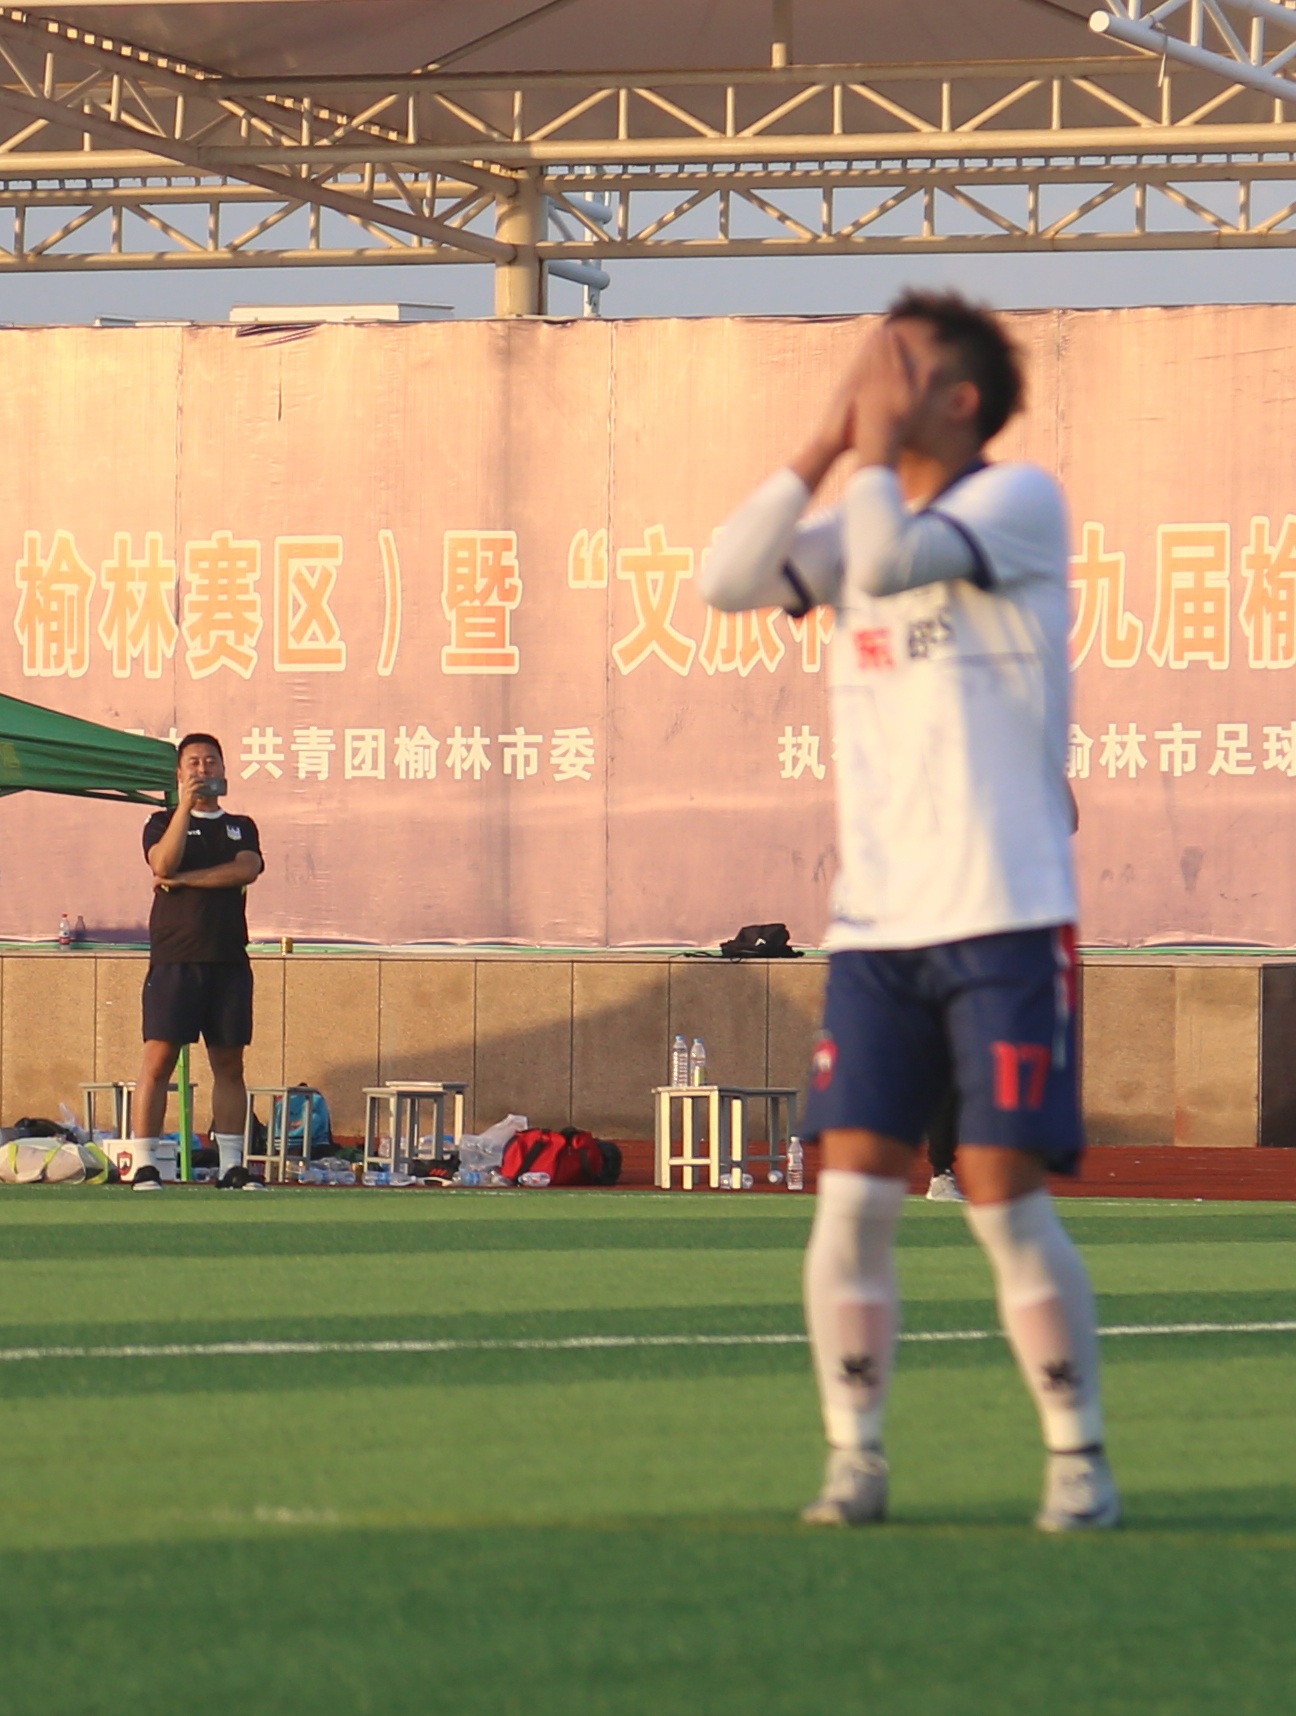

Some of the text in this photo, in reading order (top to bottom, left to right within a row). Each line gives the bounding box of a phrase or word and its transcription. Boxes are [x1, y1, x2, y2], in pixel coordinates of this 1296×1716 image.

[239, 726, 596, 782] 共青团榆林市委
[777, 725, 838, 780] 执
[990, 1041, 1050, 1112] 17
